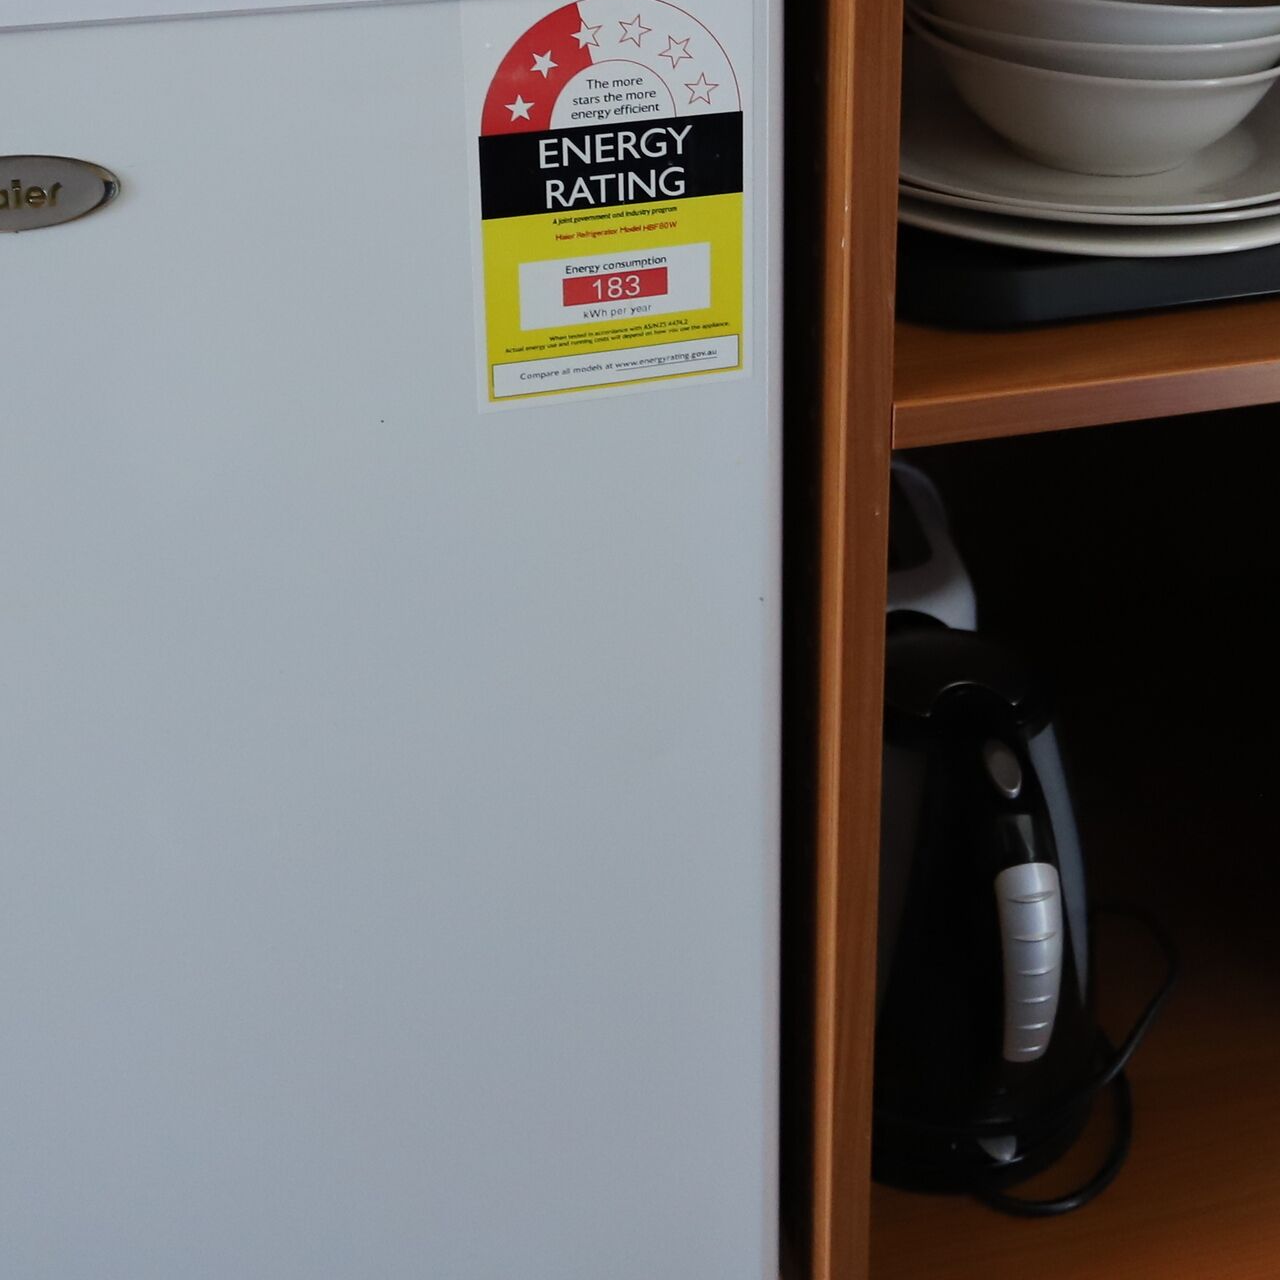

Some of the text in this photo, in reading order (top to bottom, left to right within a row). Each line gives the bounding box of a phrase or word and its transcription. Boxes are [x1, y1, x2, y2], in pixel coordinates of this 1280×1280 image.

[586, 77, 643, 90] The more
[572, 90, 656, 106] stars the more
[571, 103, 659, 120] energy efficient
[538, 124, 693, 169] ENERGY
[546, 166, 686, 209] RATING
[573, 213, 611, 223] government
[612, 211, 625, 219] and
[651, 206, 677, 215] program
[620, 225, 641, 233] Model
[565, 256, 667, 274] Energy consumption
[592, 275, 640, 300] 183
[583, 304, 652, 319] kWh per year
[520, 369, 560, 380] Compare
[573, 363, 603, 373] models
[605, 362, 614, 370] at
[615, 348, 718, 369] www.energyrating.gov.au
